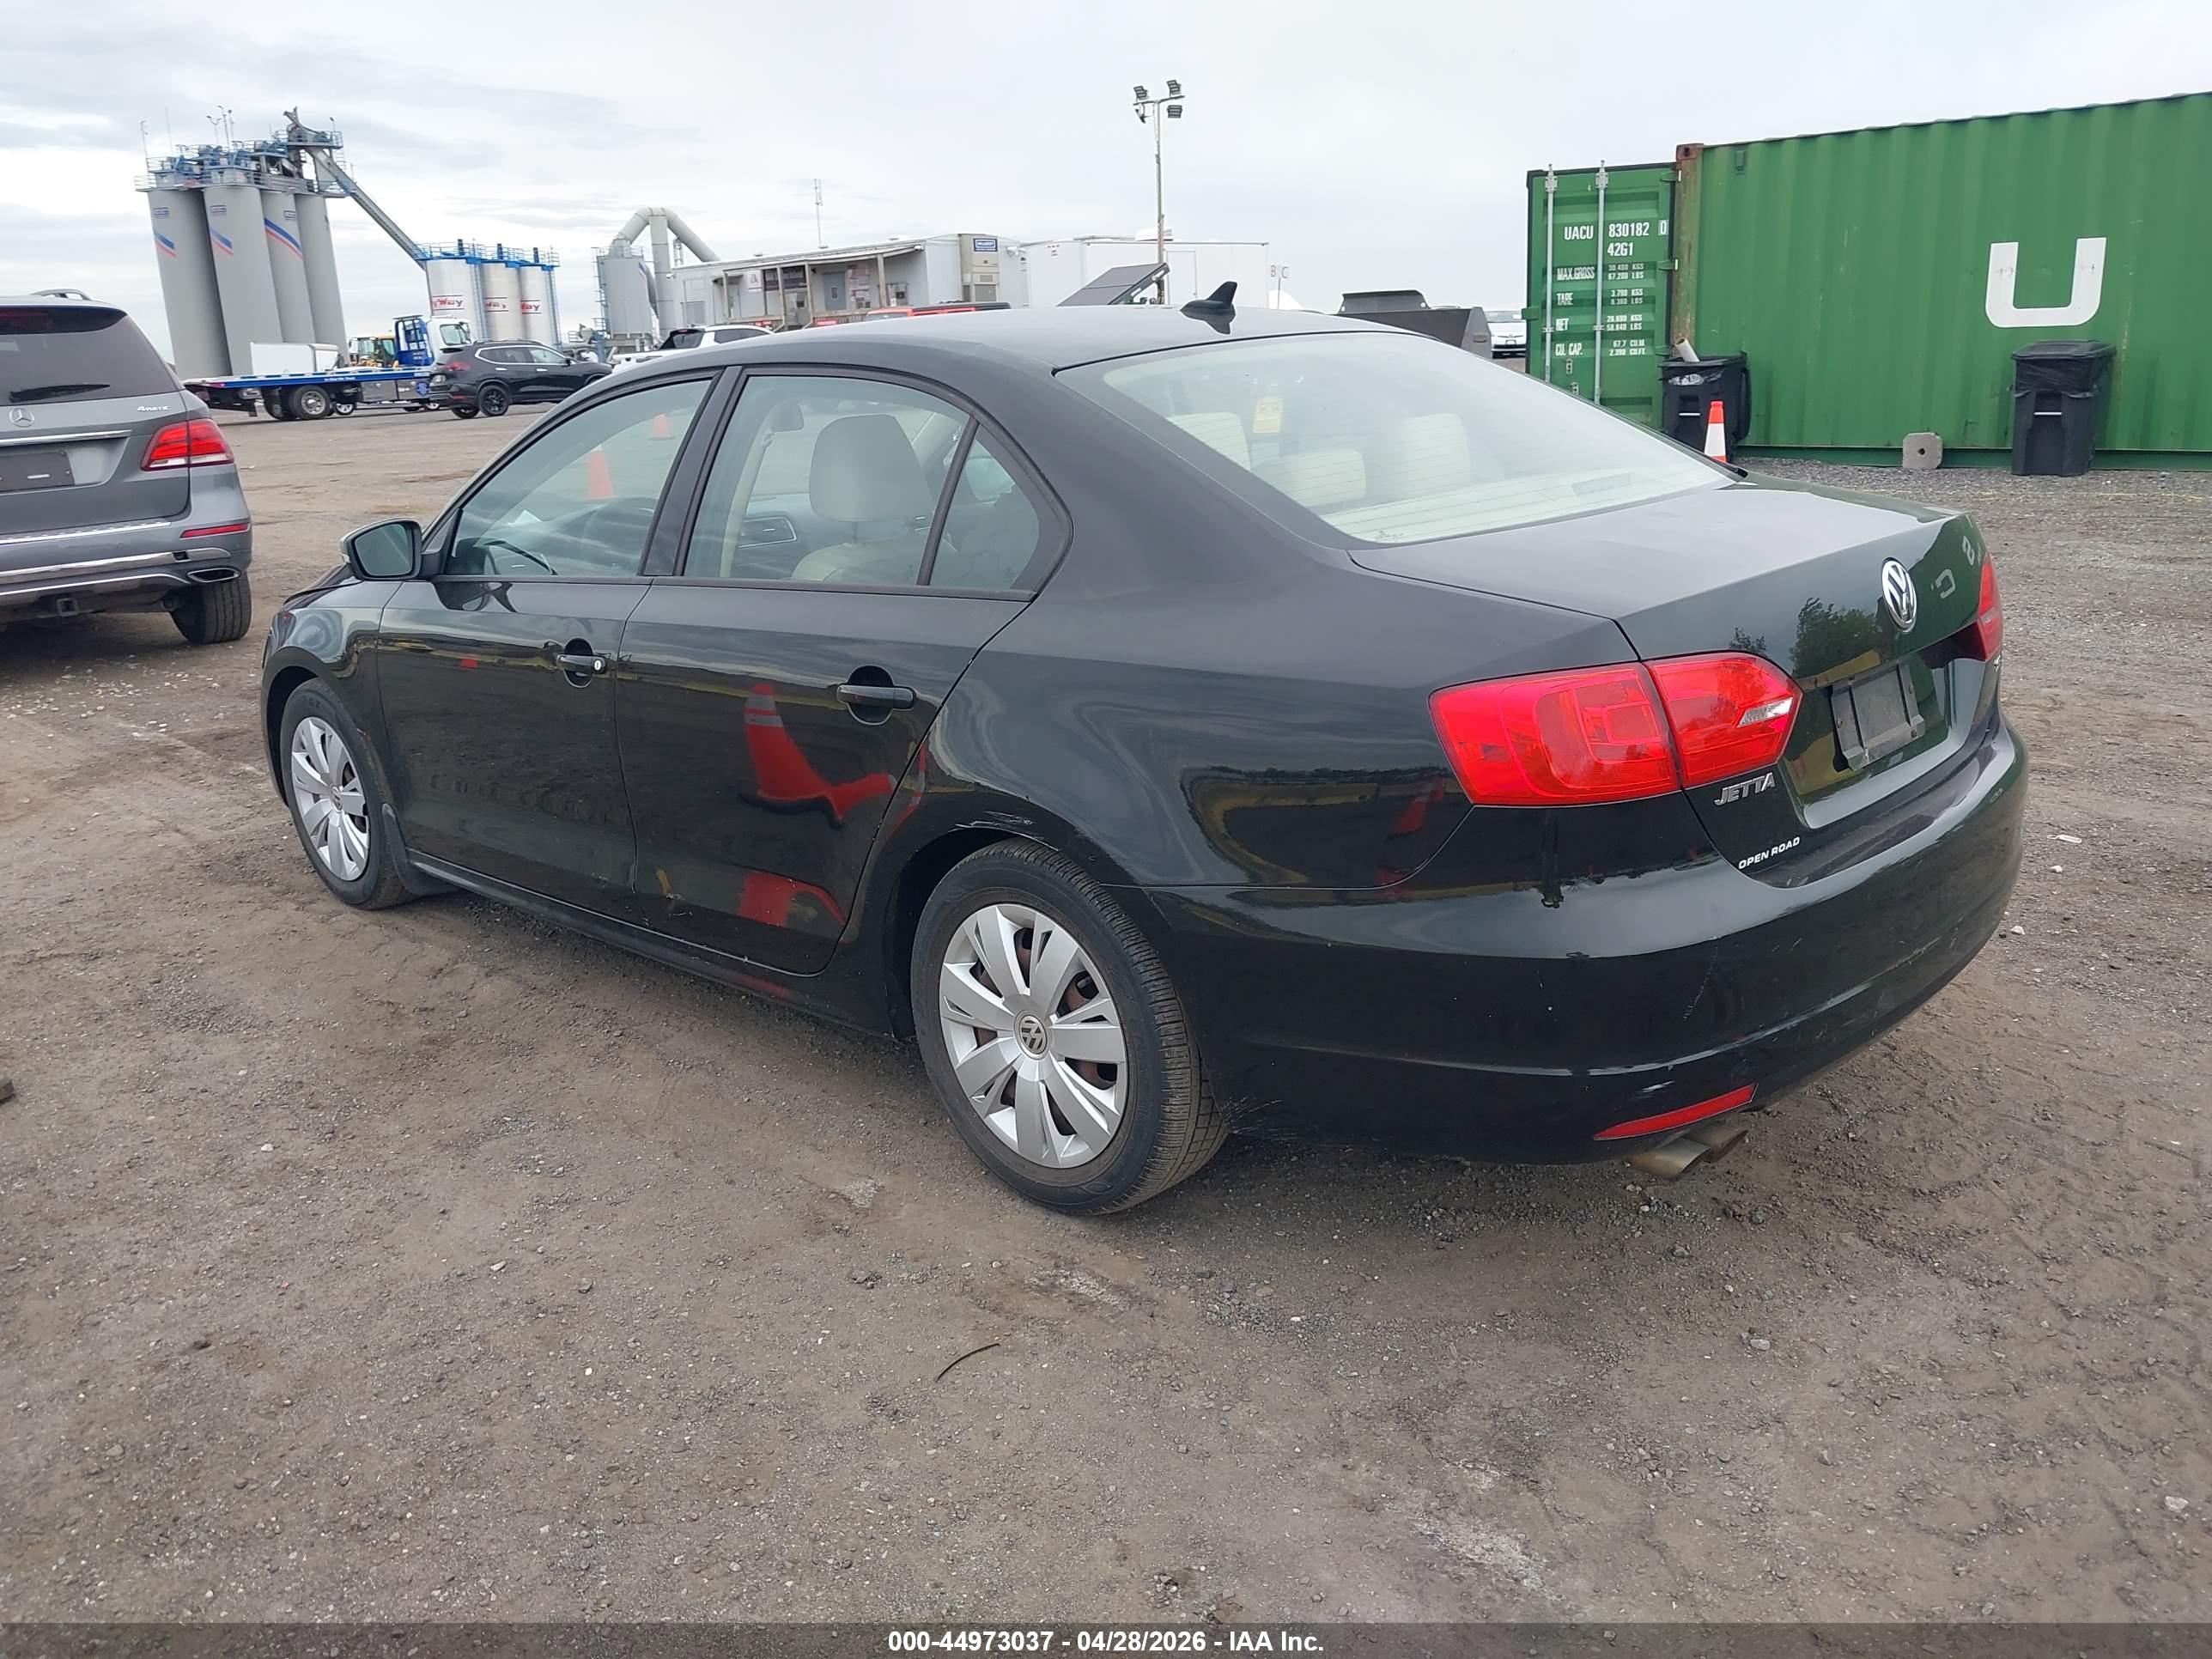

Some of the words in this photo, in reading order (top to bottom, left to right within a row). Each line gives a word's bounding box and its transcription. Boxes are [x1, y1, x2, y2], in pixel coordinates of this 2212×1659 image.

[1564, 225, 1594, 240] UACU
[1608, 222, 1650, 238] 830182
[1607, 241, 1634, 257] 42G1
[1632, 270, 1644, 279] LBS
[1985, 237, 2106, 328] U
[1556, 292, 1574, 306] TARE
[1555, 318, 1570, 331] NET
[1568, 343, 1583, 356] CAP.
[1714, 771, 1776, 806] JETTA
[1738, 849, 1770, 870] OPEN
[1771, 836, 1801, 857] ROAD
